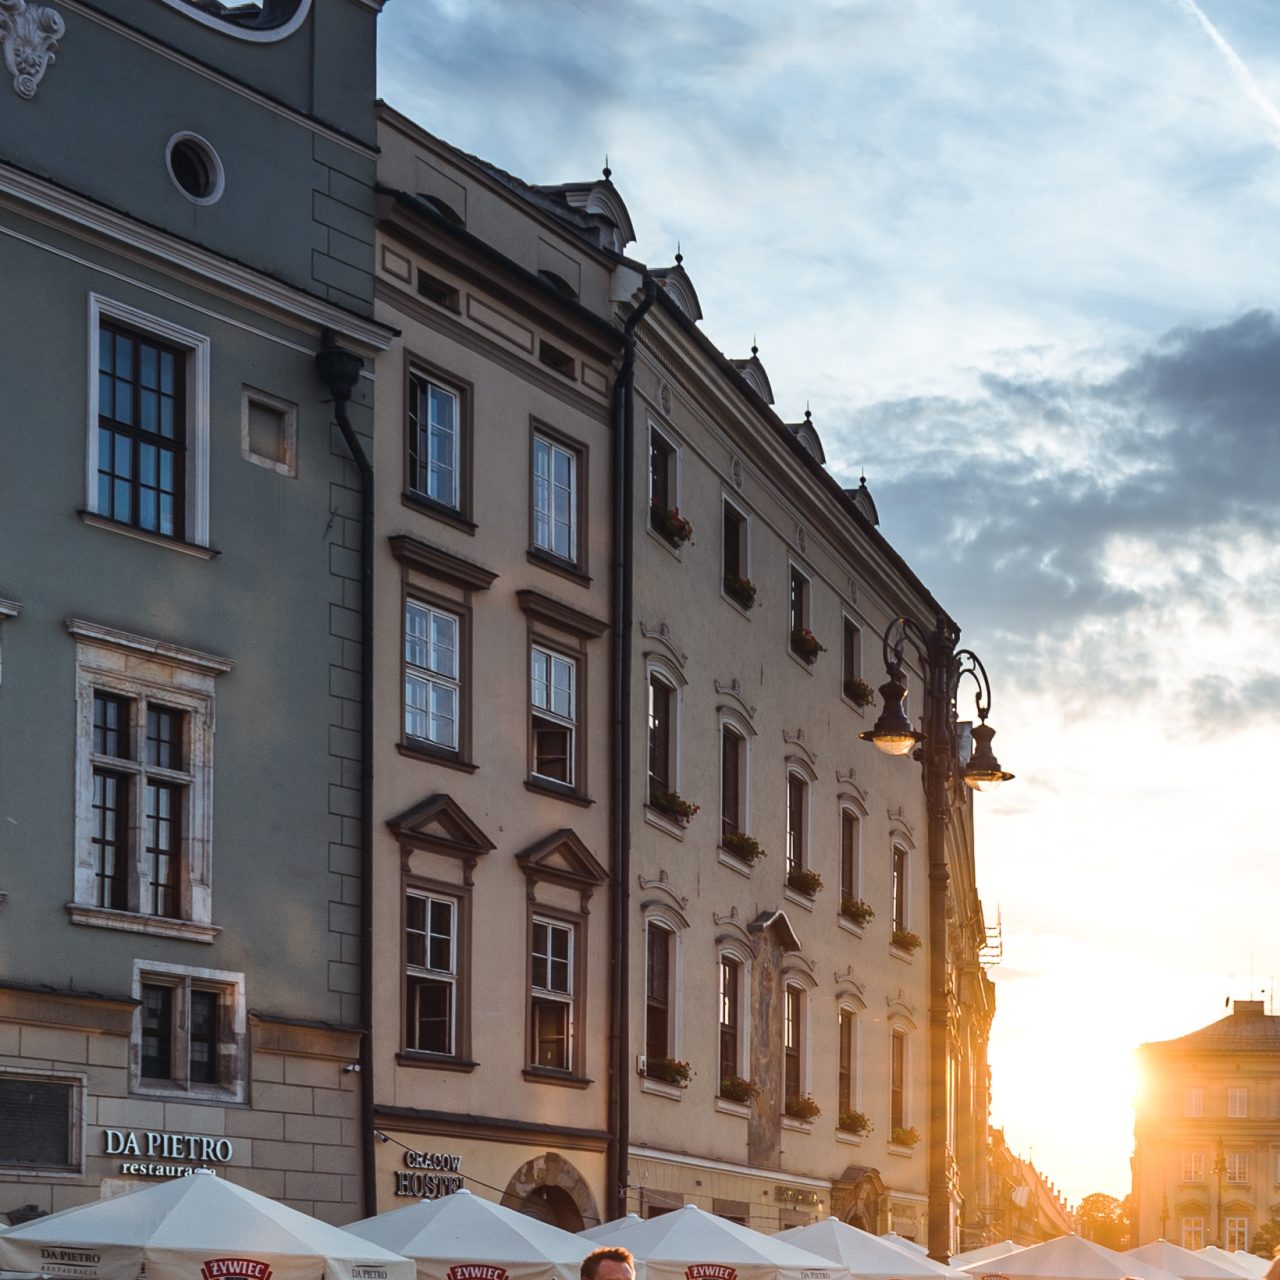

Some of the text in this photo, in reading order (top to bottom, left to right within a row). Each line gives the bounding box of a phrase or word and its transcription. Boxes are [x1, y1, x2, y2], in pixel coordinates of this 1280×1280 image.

[104, 1129, 233, 1162] DA PIETRO
[404, 1150, 462, 1171] CRACOW
[41, 1249, 101, 1263] DA PIETRO
